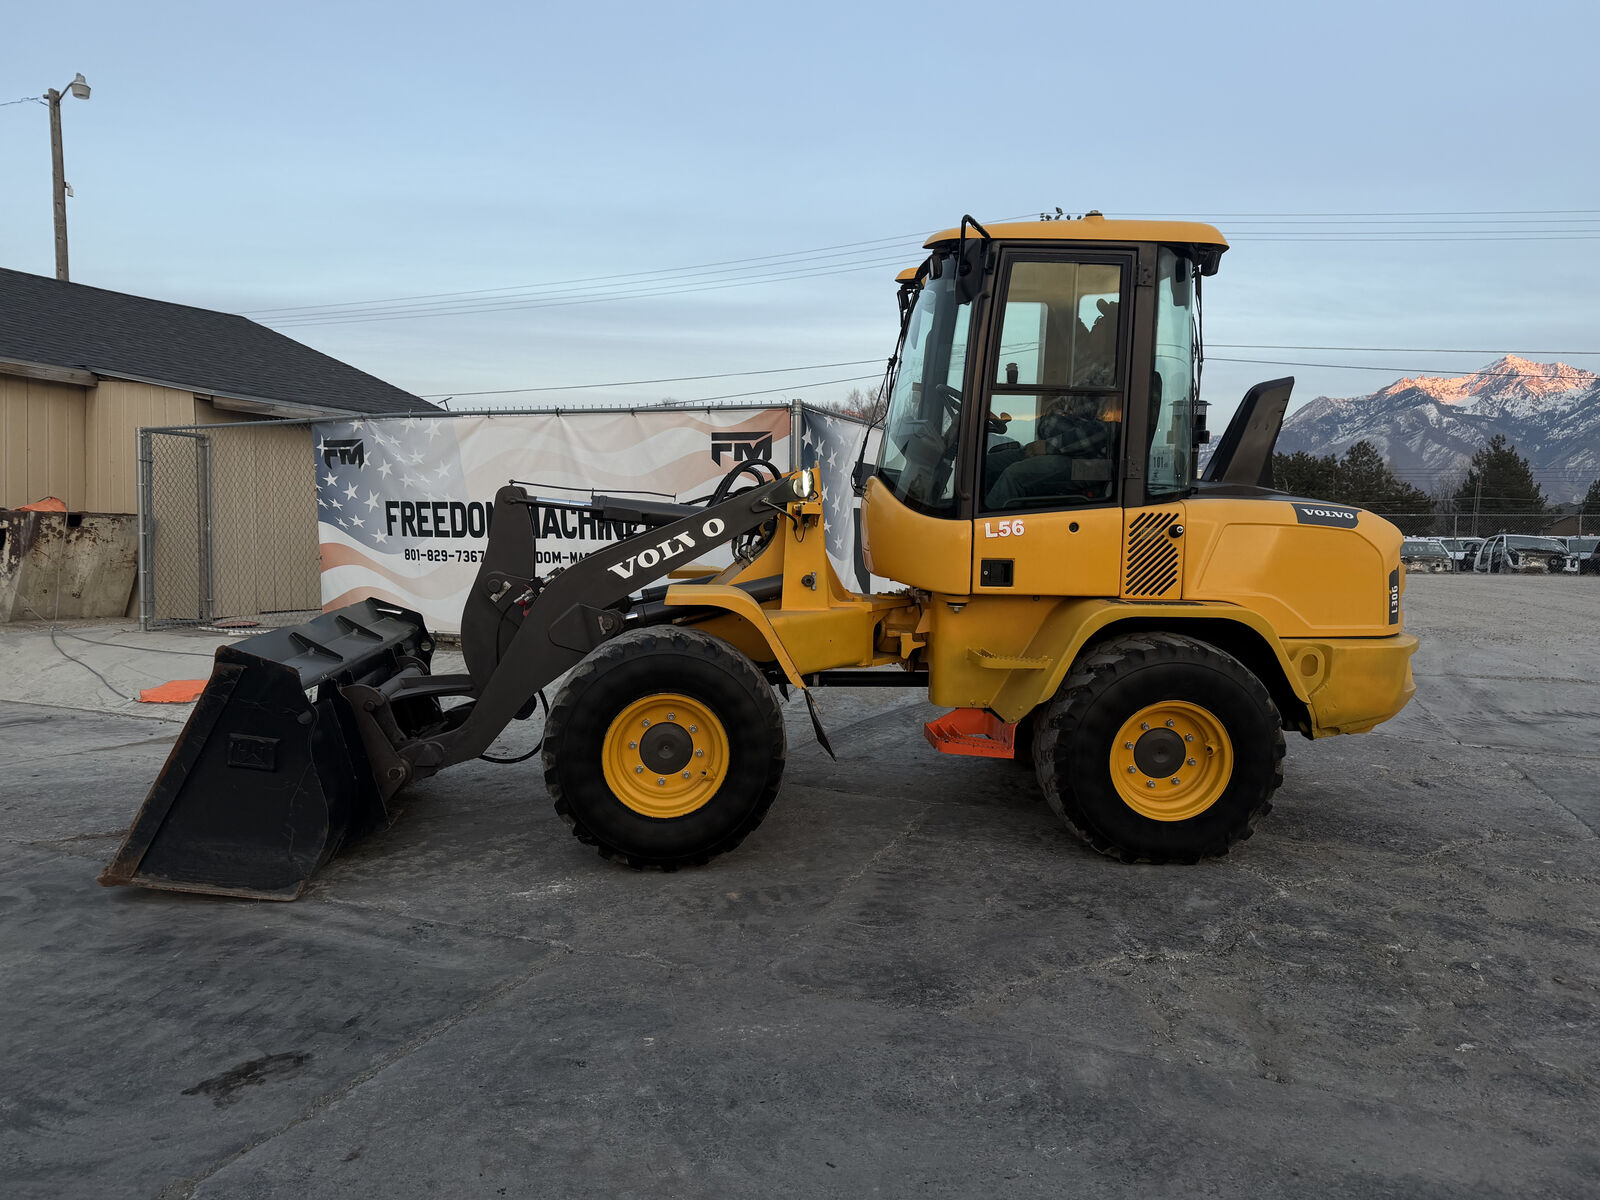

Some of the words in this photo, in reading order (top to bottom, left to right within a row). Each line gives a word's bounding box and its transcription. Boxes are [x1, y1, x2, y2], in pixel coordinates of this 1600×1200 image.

[323, 438, 365, 470] FM
[712, 431, 773, 467] FM
[1301, 508, 1354, 519] VOLVO
[985, 520, 1025, 538] L56
[404, 549, 484, 562] 801-829-7367
[1391, 585, 1399, 614] L30G
